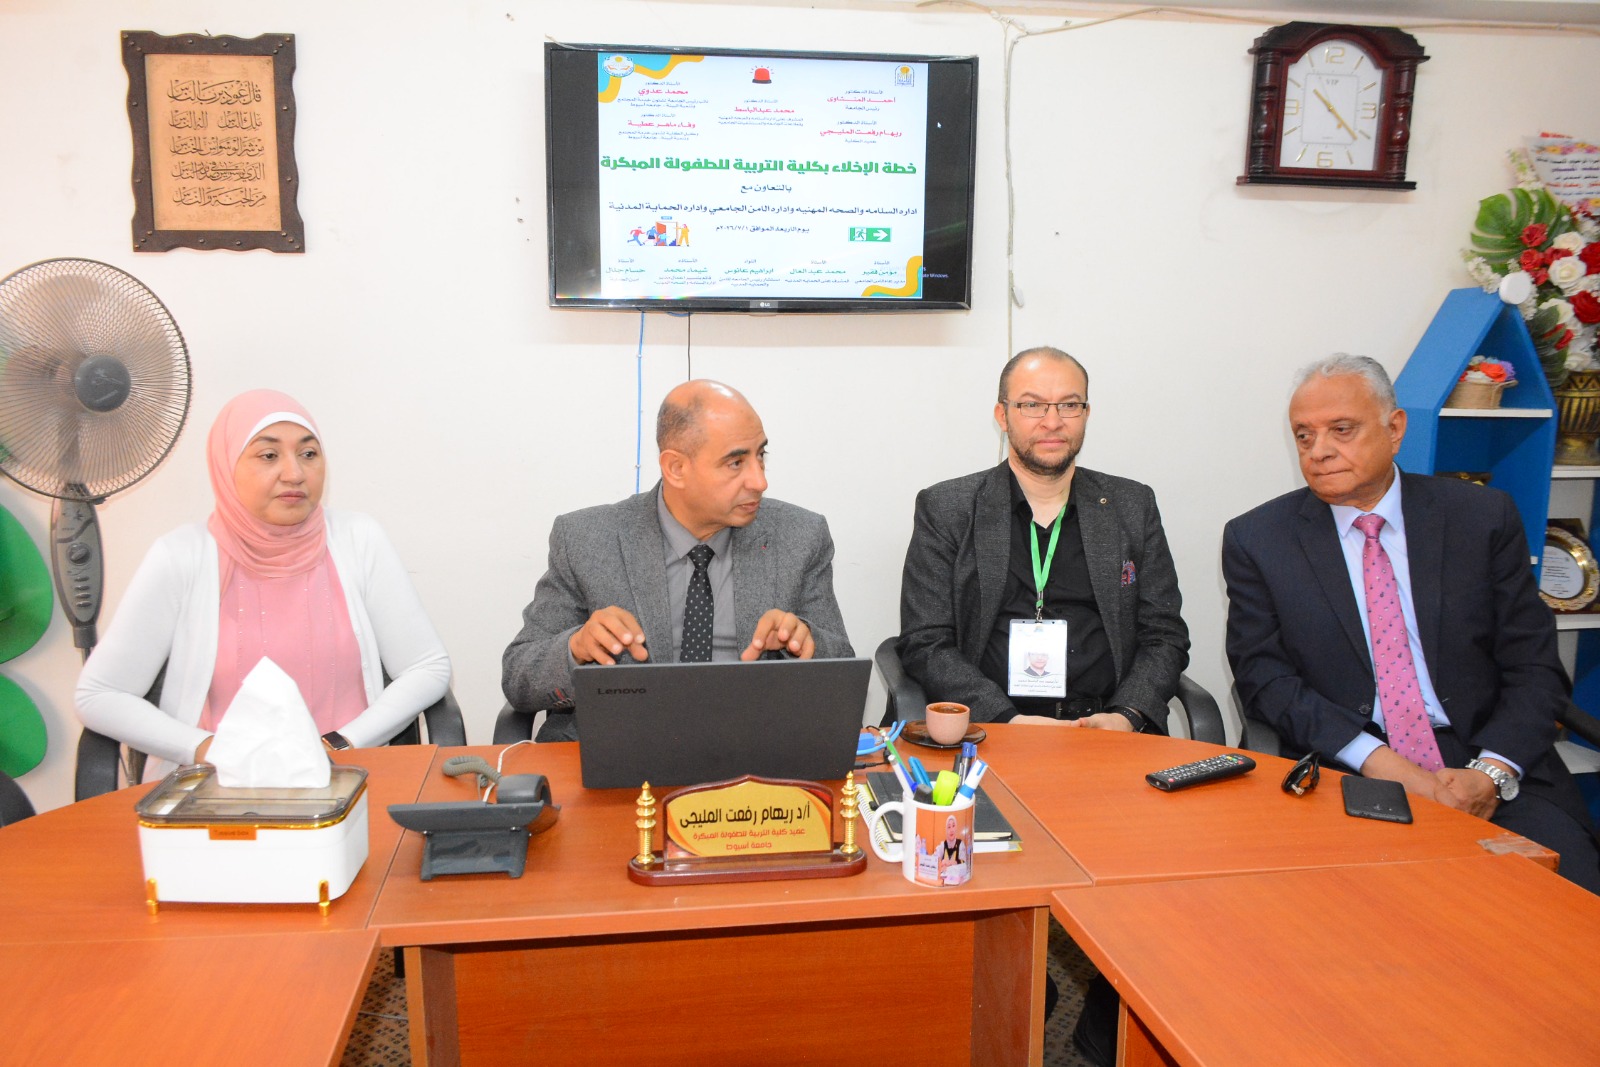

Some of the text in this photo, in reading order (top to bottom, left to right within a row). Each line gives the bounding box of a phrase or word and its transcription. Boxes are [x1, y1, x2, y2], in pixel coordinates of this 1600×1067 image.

[1326, 47, 1344, 64] 12
[1361, 103, 1376, 119] 3
[1317, 152, 1333, 168] 6
[600, 156, 917, 176] خطة الإخلاء بكلية التربية للطفولة المبكرة
[754, 184, 792, 193] بالتعاون
[609, 202, 644, 212] المدنية
[645, 203, 682, 212] الحماية
[709, 205, 746, 215] الجامعي
[680, 801, 810, 828] أ/د ريهام رفعت المليجى
[721, 831, 747, 839] للطفولة
[749, 829, 769, 837] التربية
[726, 842, 749, 850] أسيوط
